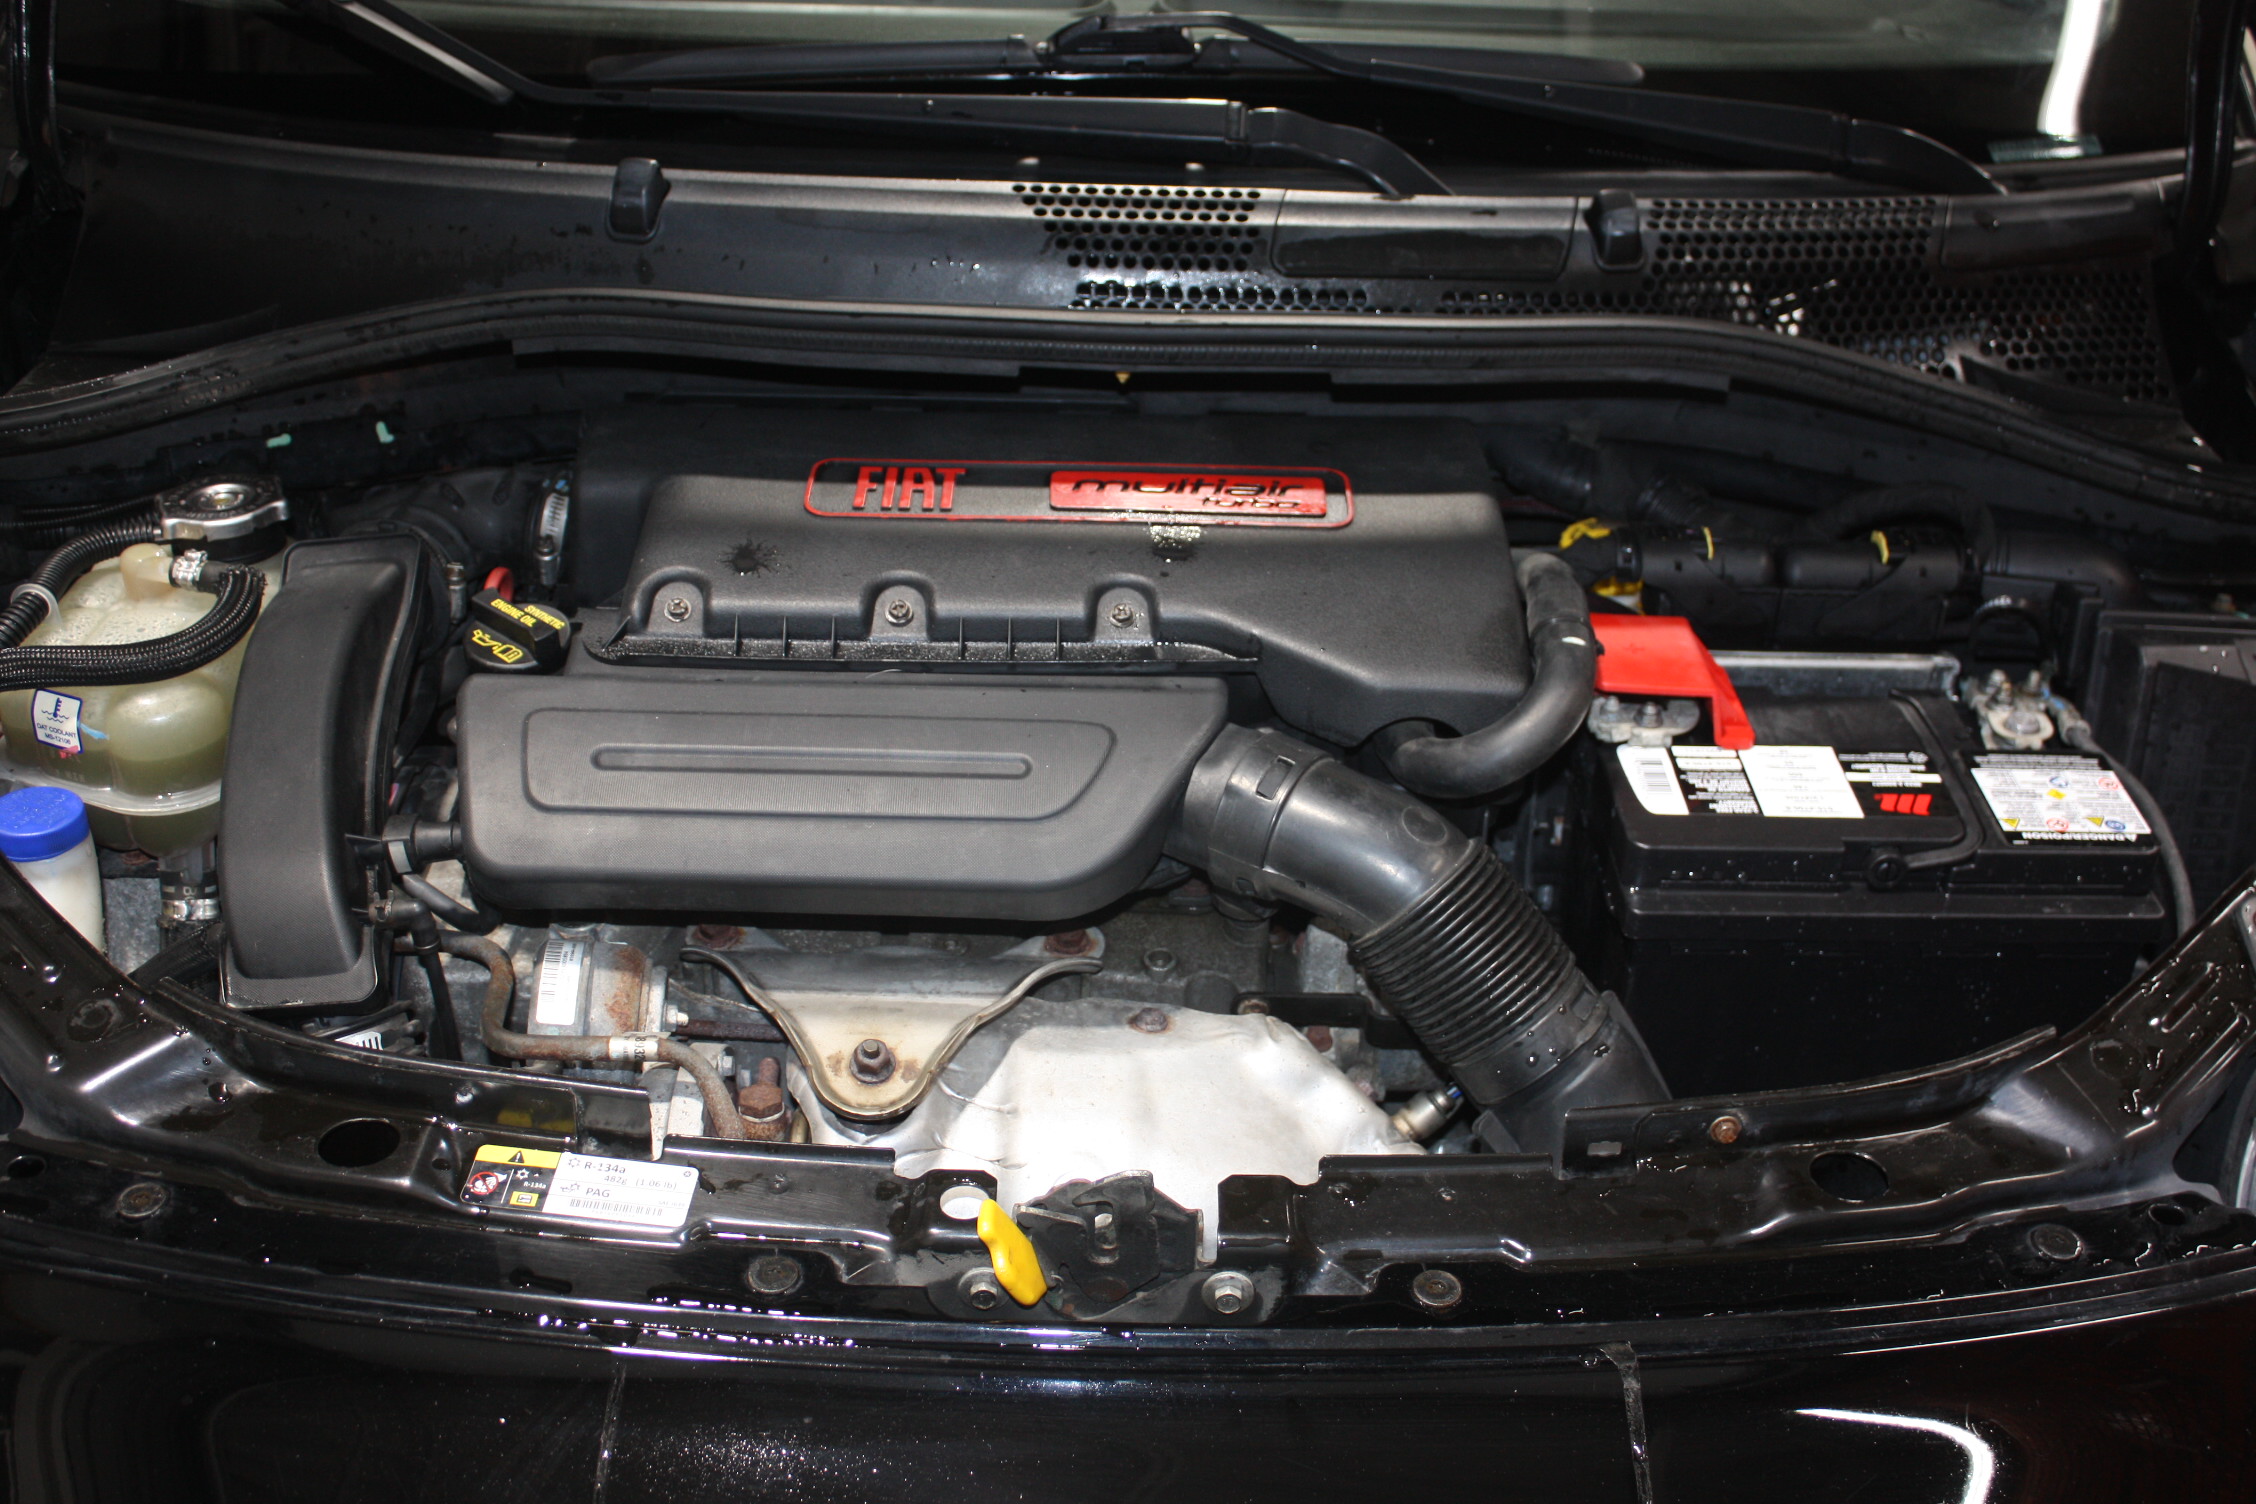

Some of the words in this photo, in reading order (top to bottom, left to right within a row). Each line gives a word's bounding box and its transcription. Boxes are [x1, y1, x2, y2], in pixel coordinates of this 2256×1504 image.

[852, 466, 967, 510] FIAT
[1072, 478, 1306, 497] multiair
[1200, 496, 1301, 509] turbo
[491, 599, 524, 619] ENGINE
[520, 614, 537, 628] OIL
[524, 605, 565, 630] SYNTHETIC
[49, 726, 76, 738] COOLANT
[584, 1161, 627, 1174] R-134a
[523, 1180, 547, 1189] R-134a
[585, 1187, 611, 1198] PAG
